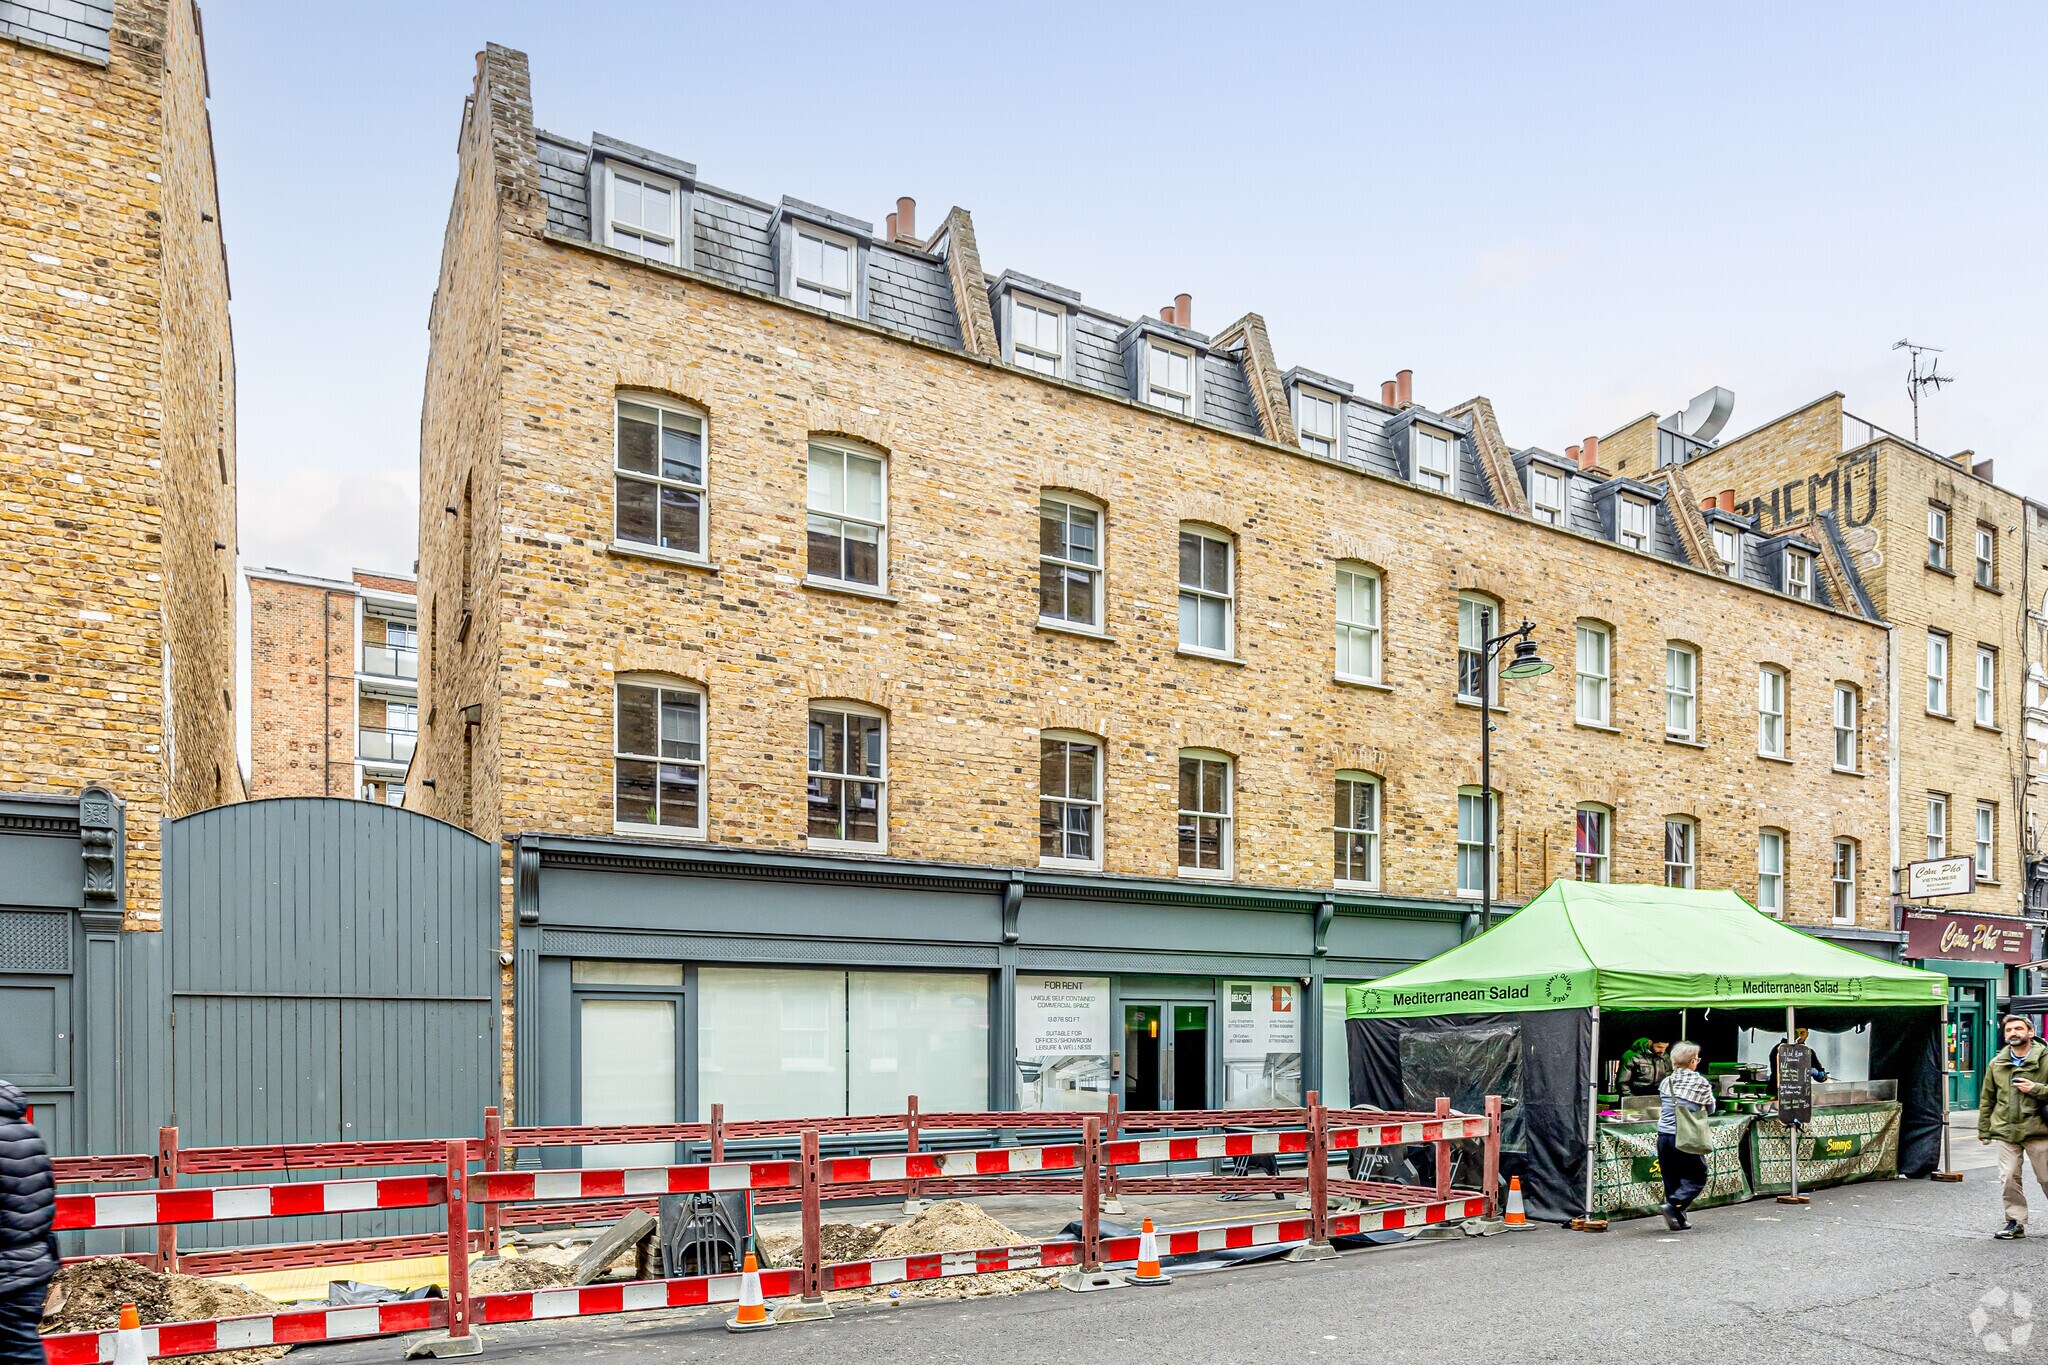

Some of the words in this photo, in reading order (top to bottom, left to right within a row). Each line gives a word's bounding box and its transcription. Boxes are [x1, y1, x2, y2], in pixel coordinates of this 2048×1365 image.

[1044, 981, 1061, 990] FOR
[1062, 982, 1083, 990] RENT
[1545, 974, 1558, 997] SUNNY
[1560, 973, 1572, 991] OLIVE
[1742, 981, 1812, 994] Mediterranean
[1814, 980, 1839, 994] Salad
[1393, 988, 1485, 1006] Mediterranean
[1489, 984, 1529, 1000] Salad
[1552, 993, 1569, 1002] TREE
[1826, 1138, 1852, 1153] Sunnys
